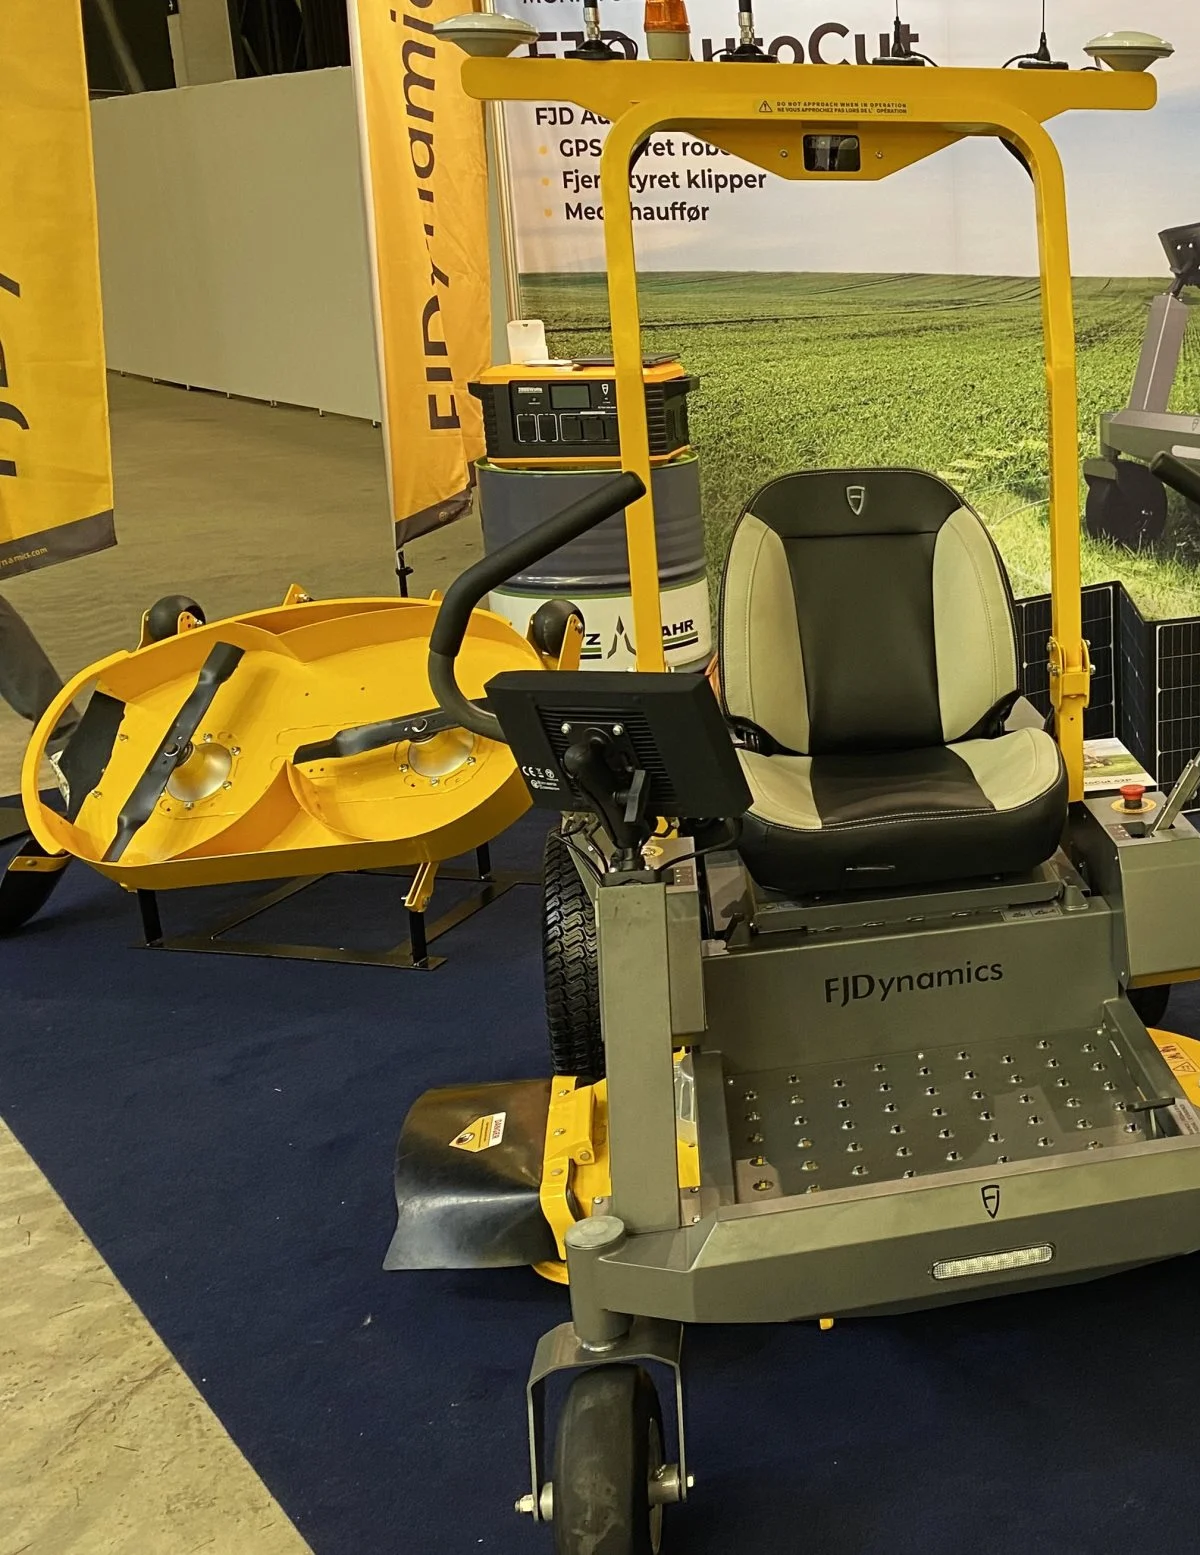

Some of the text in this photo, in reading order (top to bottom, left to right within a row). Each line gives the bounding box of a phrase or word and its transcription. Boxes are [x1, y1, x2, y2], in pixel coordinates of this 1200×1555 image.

[535, 107, 574, 126] FJD
[687, 168, 767, 193] klipper
[630, 201, 709, 222] hauffør
[824, 961, 1003, 1007] FJDynamics
